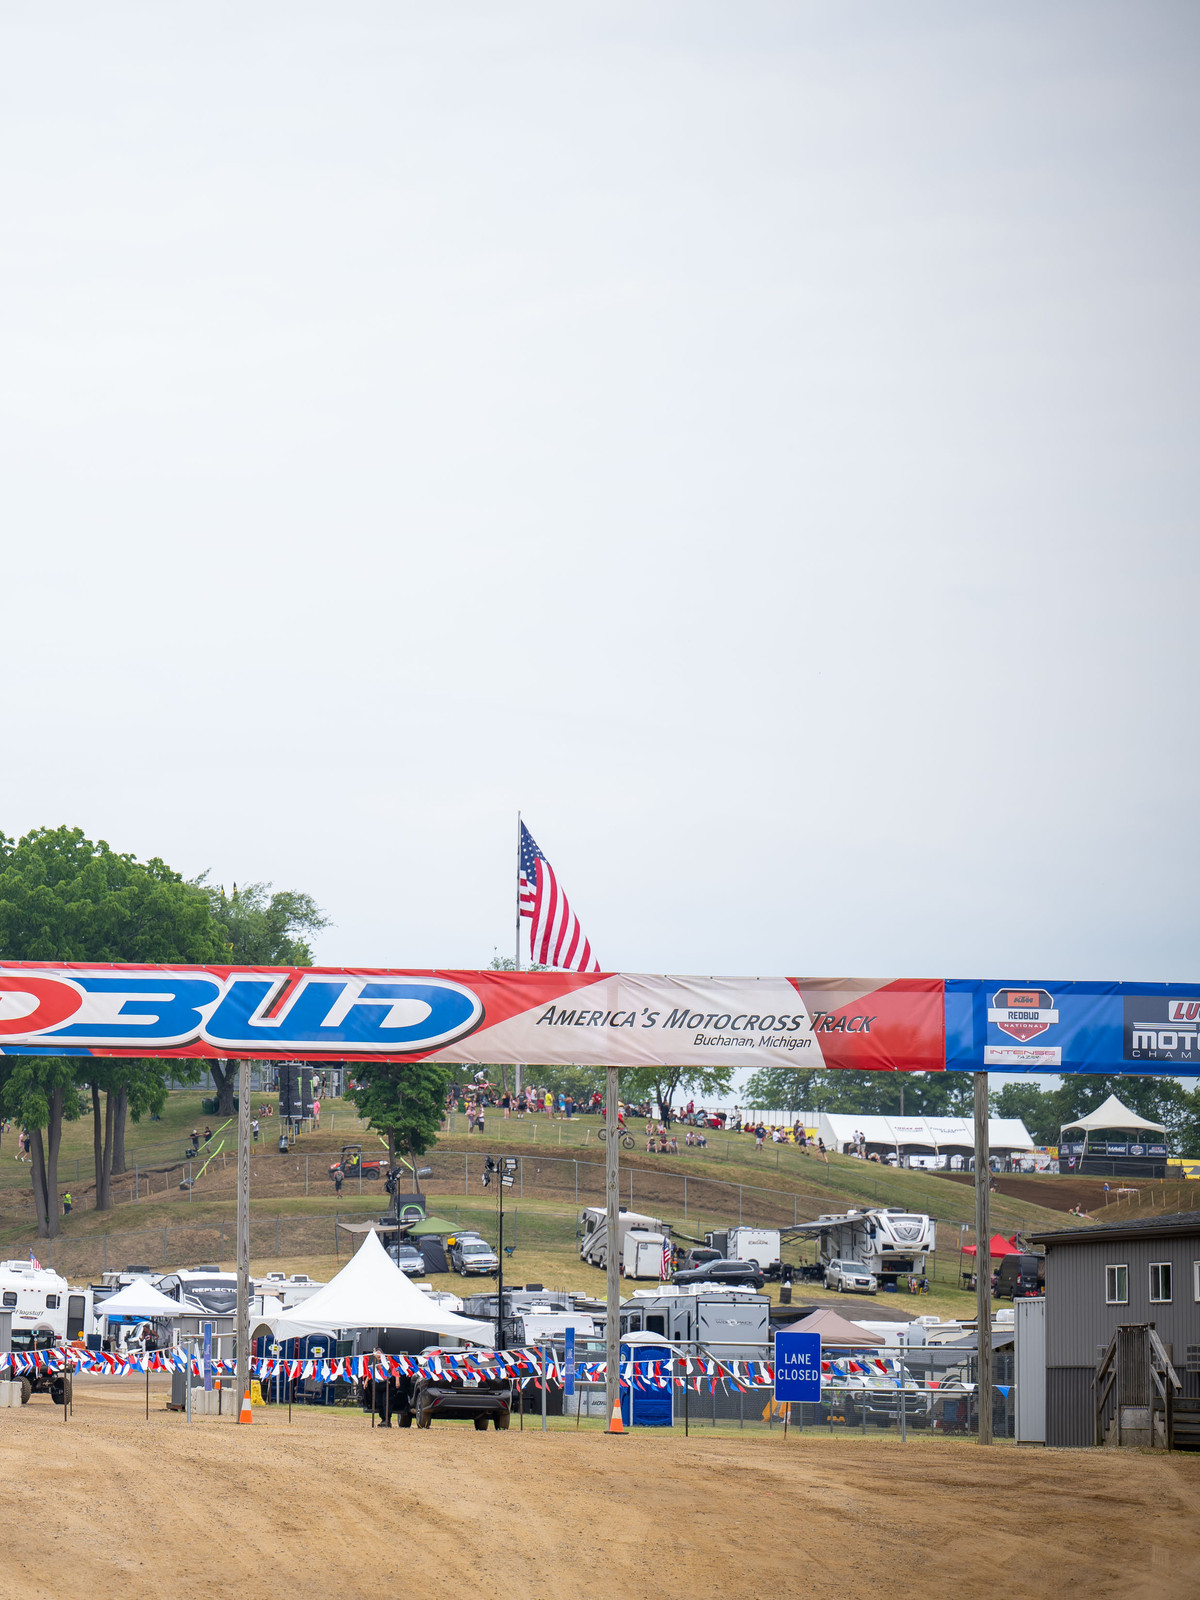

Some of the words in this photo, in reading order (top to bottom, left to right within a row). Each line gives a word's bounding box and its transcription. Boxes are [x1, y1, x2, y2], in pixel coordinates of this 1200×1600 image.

[535, 1005, 660, 1029] AMERICA'S
[662, 1008, 805, 1032] MOTOCROSS
[809, 1011, 877, 1033] TRACK
[1007, 1011, 1040, 1020] REDBUD
[1173, 1002, 1200, 1020] LU
[693, 1034, 755, 1048] Buchanan,
[758, 1035, 812, 1050] Michigan
[1132, 1031, 1200, 1050] MOT
[784, 1353, 811, 1365] LANE
[777, 1369, 818, 1381] CLOSED
